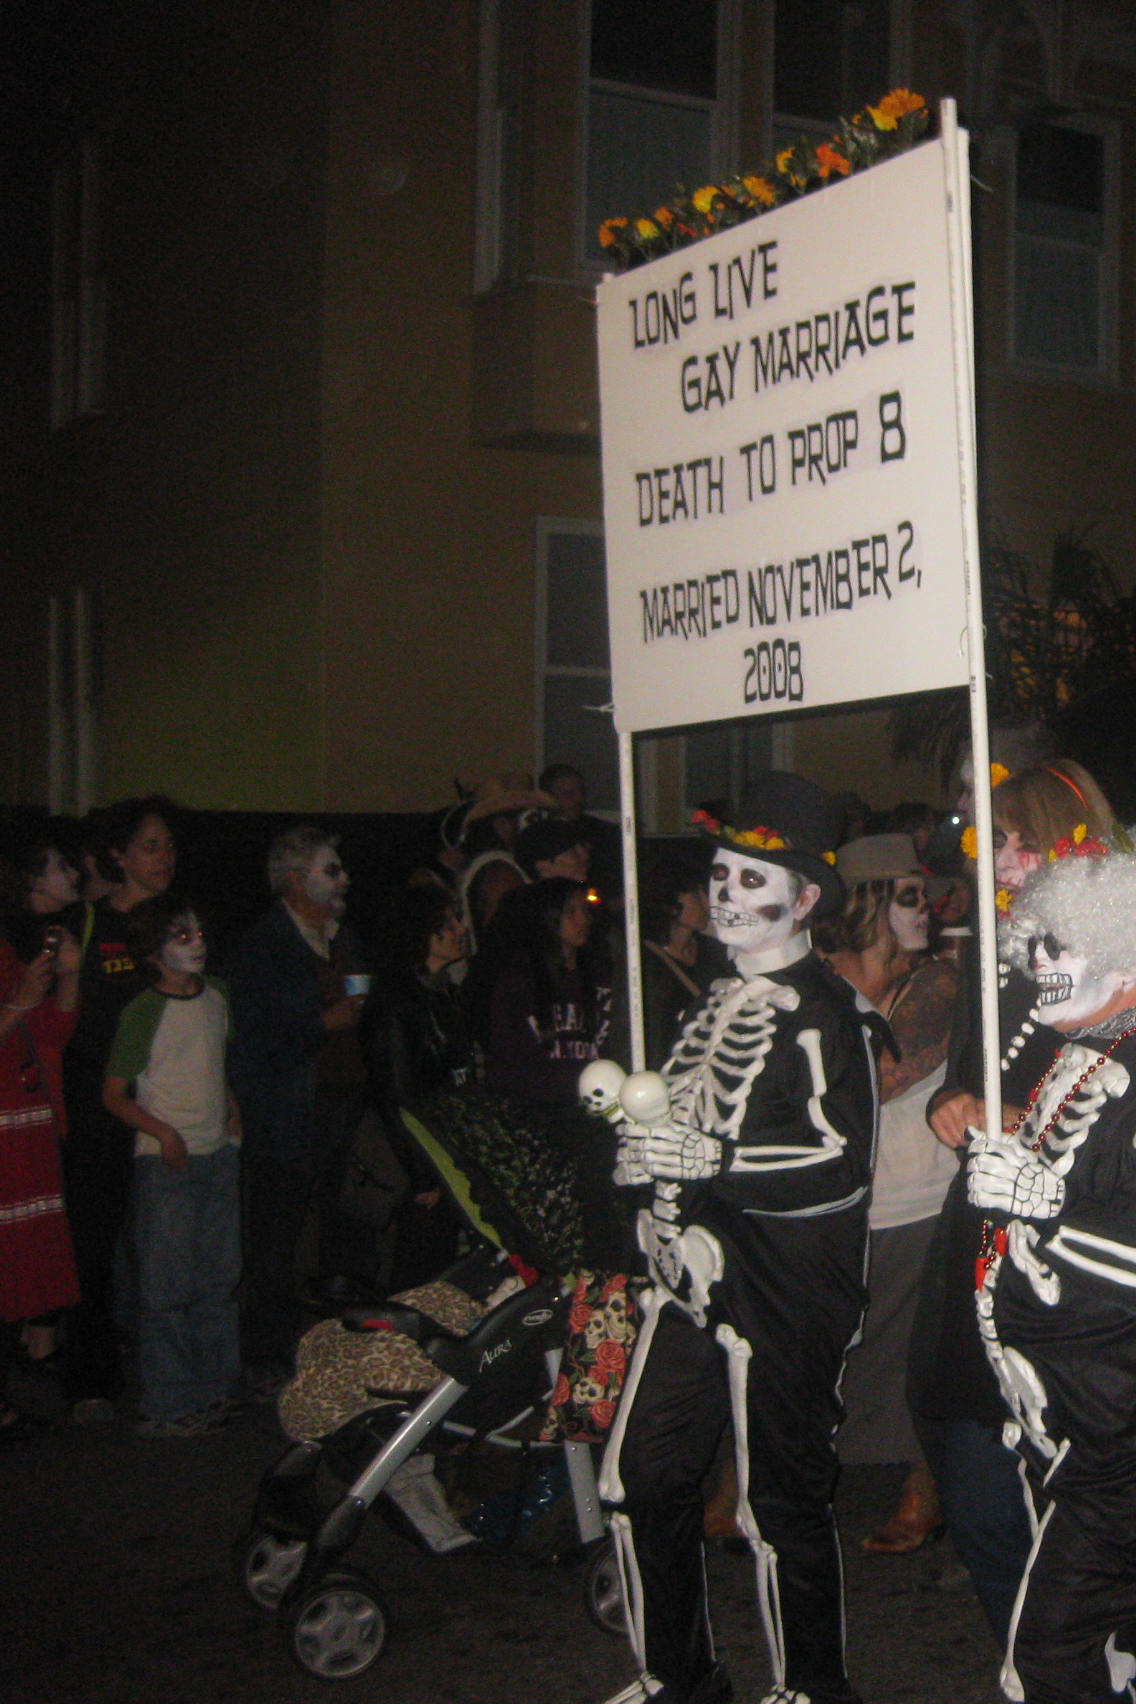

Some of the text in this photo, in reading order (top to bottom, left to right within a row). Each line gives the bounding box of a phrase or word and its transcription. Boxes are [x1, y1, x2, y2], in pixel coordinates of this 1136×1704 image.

[629, 240, 778, 348] LONG LIVE
[681, 281, 916, 413] GAY MARRIAGE
[635, 390, 906, 527] DEATH TO PROP 8
[640, 569, 740, 644] MARRIED
[748, 533, 892, 628] NOVEMBER
[898, 520, 922, 589] 2,
[744, 638, 804, 704] 2008
